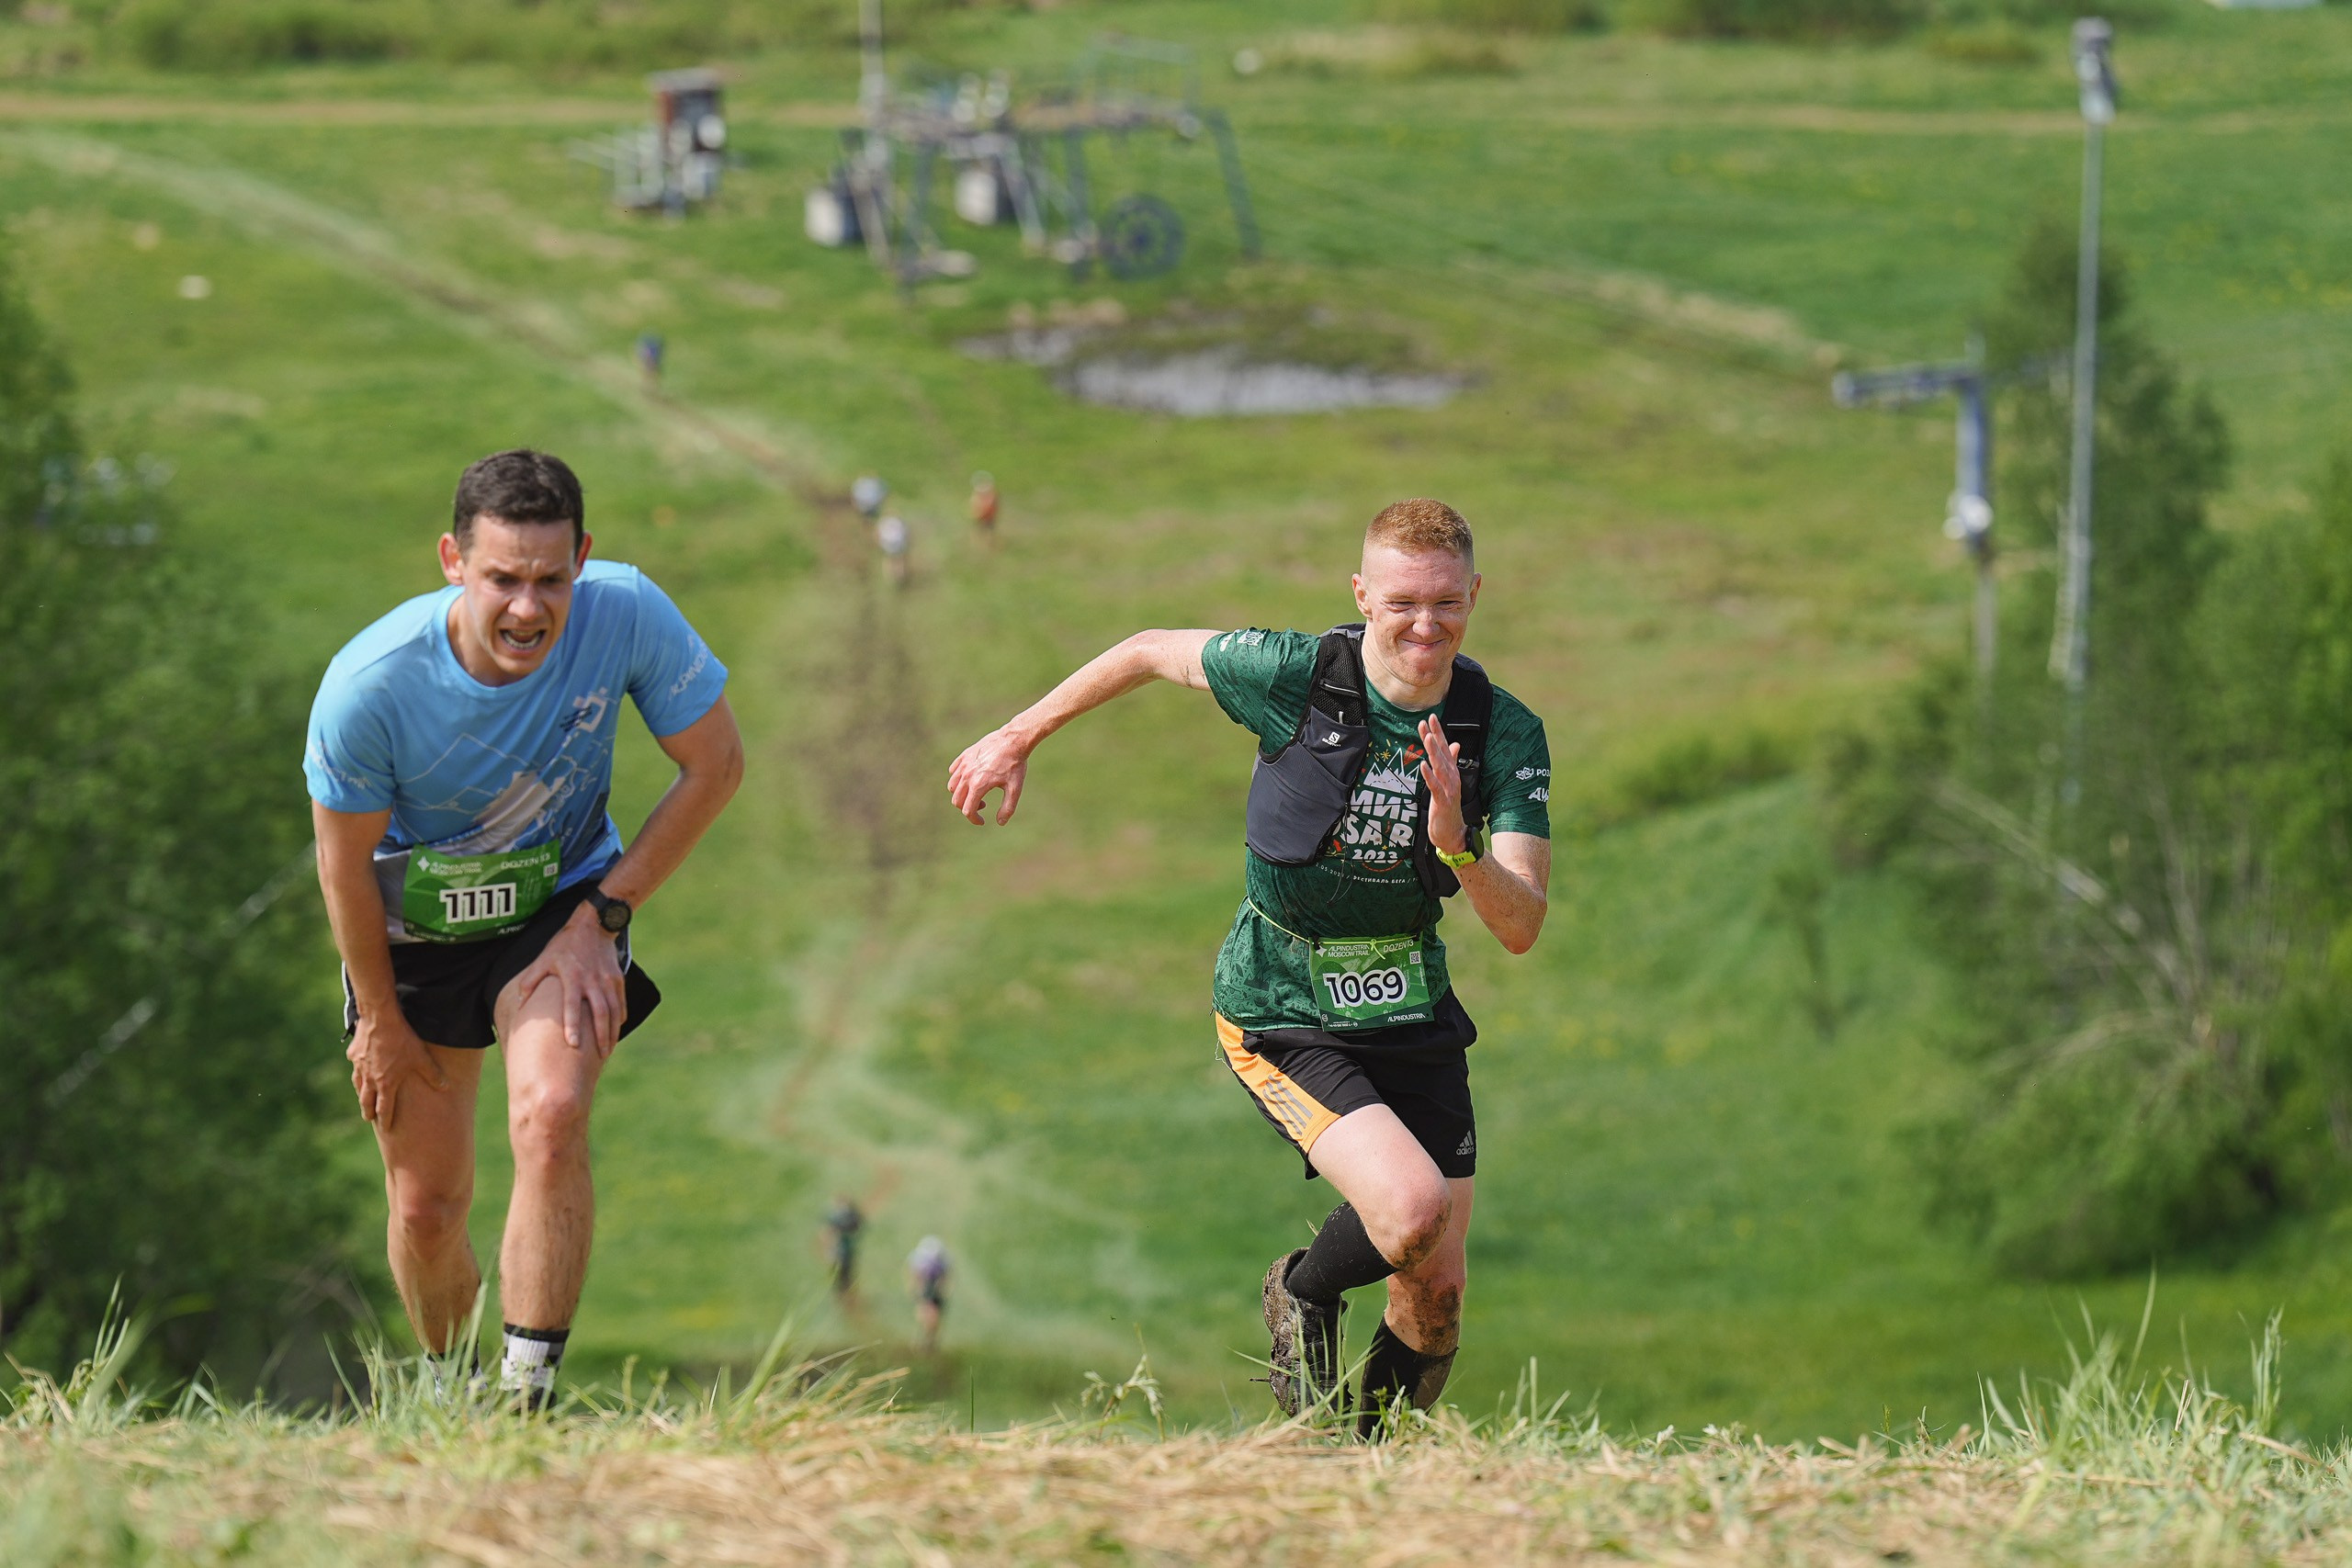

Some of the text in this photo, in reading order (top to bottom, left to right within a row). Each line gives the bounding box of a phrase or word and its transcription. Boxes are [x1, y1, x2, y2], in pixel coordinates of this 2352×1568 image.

[1352, 849, 1398, 864] 2023
[441, 884, 515, 922] 1111
[1324, 968, 1406, 1007] 1069
[1387, 1013, 1426, 1022] ALPINDUSTRIA
